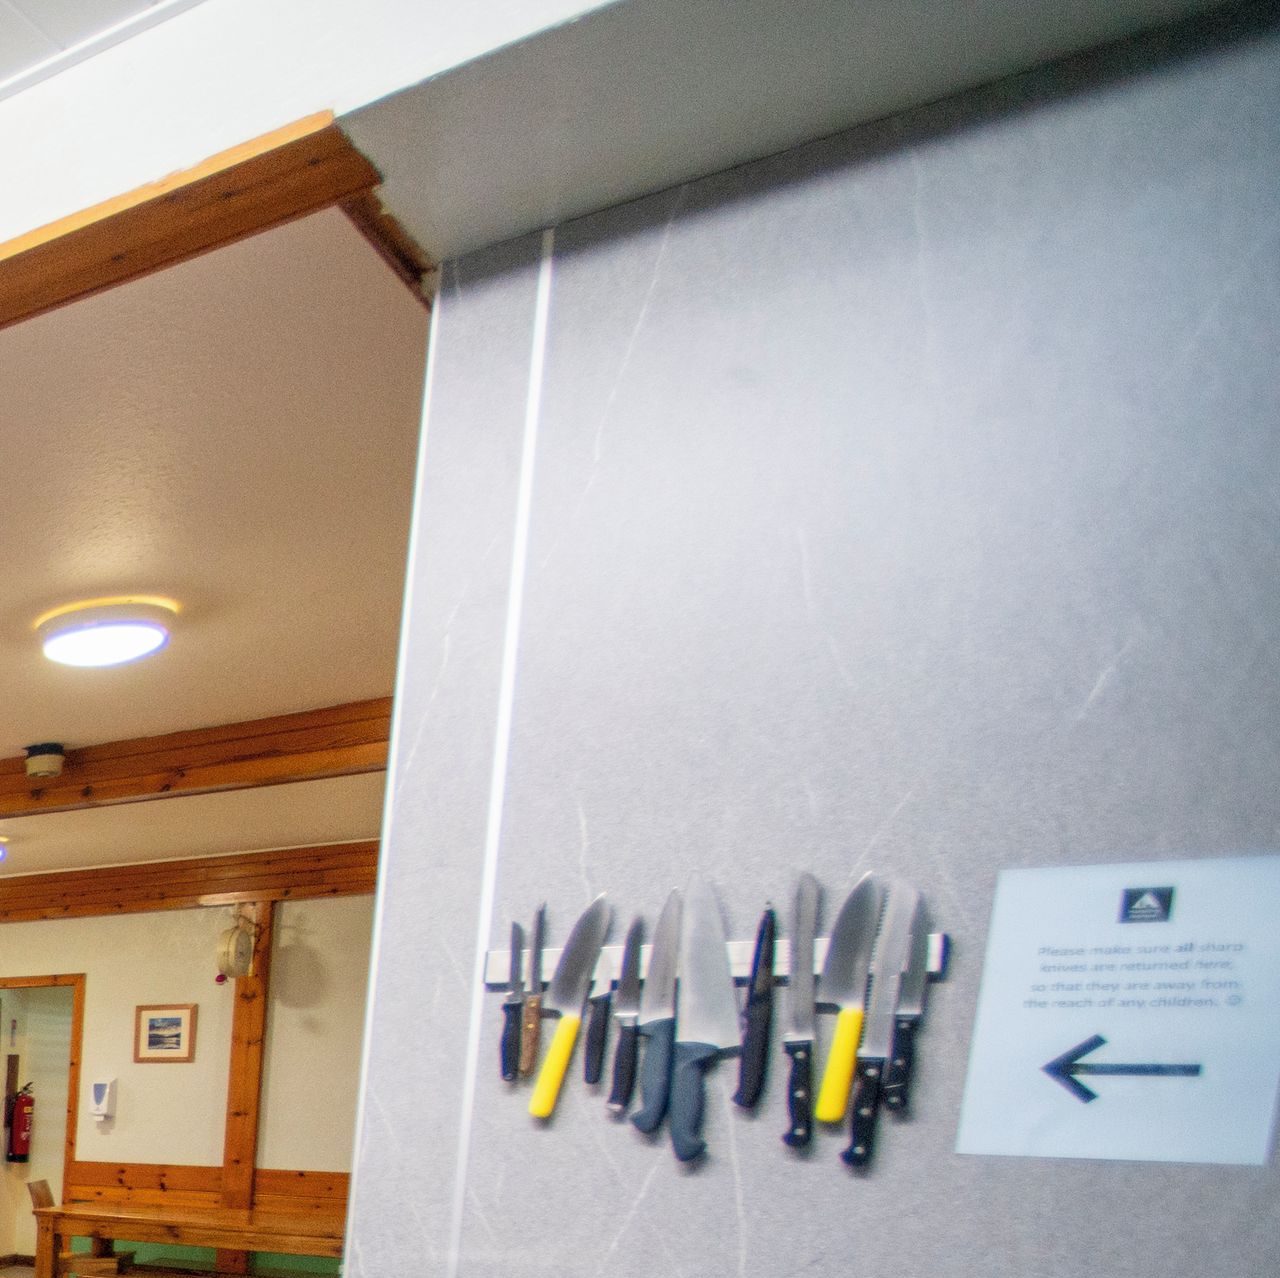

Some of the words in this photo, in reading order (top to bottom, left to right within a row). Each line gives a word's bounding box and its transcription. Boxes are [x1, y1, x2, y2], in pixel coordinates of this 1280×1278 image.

[1039, 944, 1085, 956] Please
[1093, 944, 1131, 955] make
[1137, 945, 1170, 954] sure
[1175, 942, 1194, 953] all
[1199, 942, 1244, 954] sharp
[1040, 961, 1087, 972] knives
[1092, 963, 1115, 972] are
[1120, 960, 1190, 971] returned
[1031, 983, 1046, 992] so
[1052, 980, 1081, 991] that
[1086, 980, 1119, 993] they
[1125, 982, 1149, 991] are
[1153, 981, 1196, 992] away
[1023, 998, 1047, 1008] the
[1054, 998, 1093, 1008] reach
[1098, 998, 1117, 1008] of
[1119, 999, 1146, 1010] any
